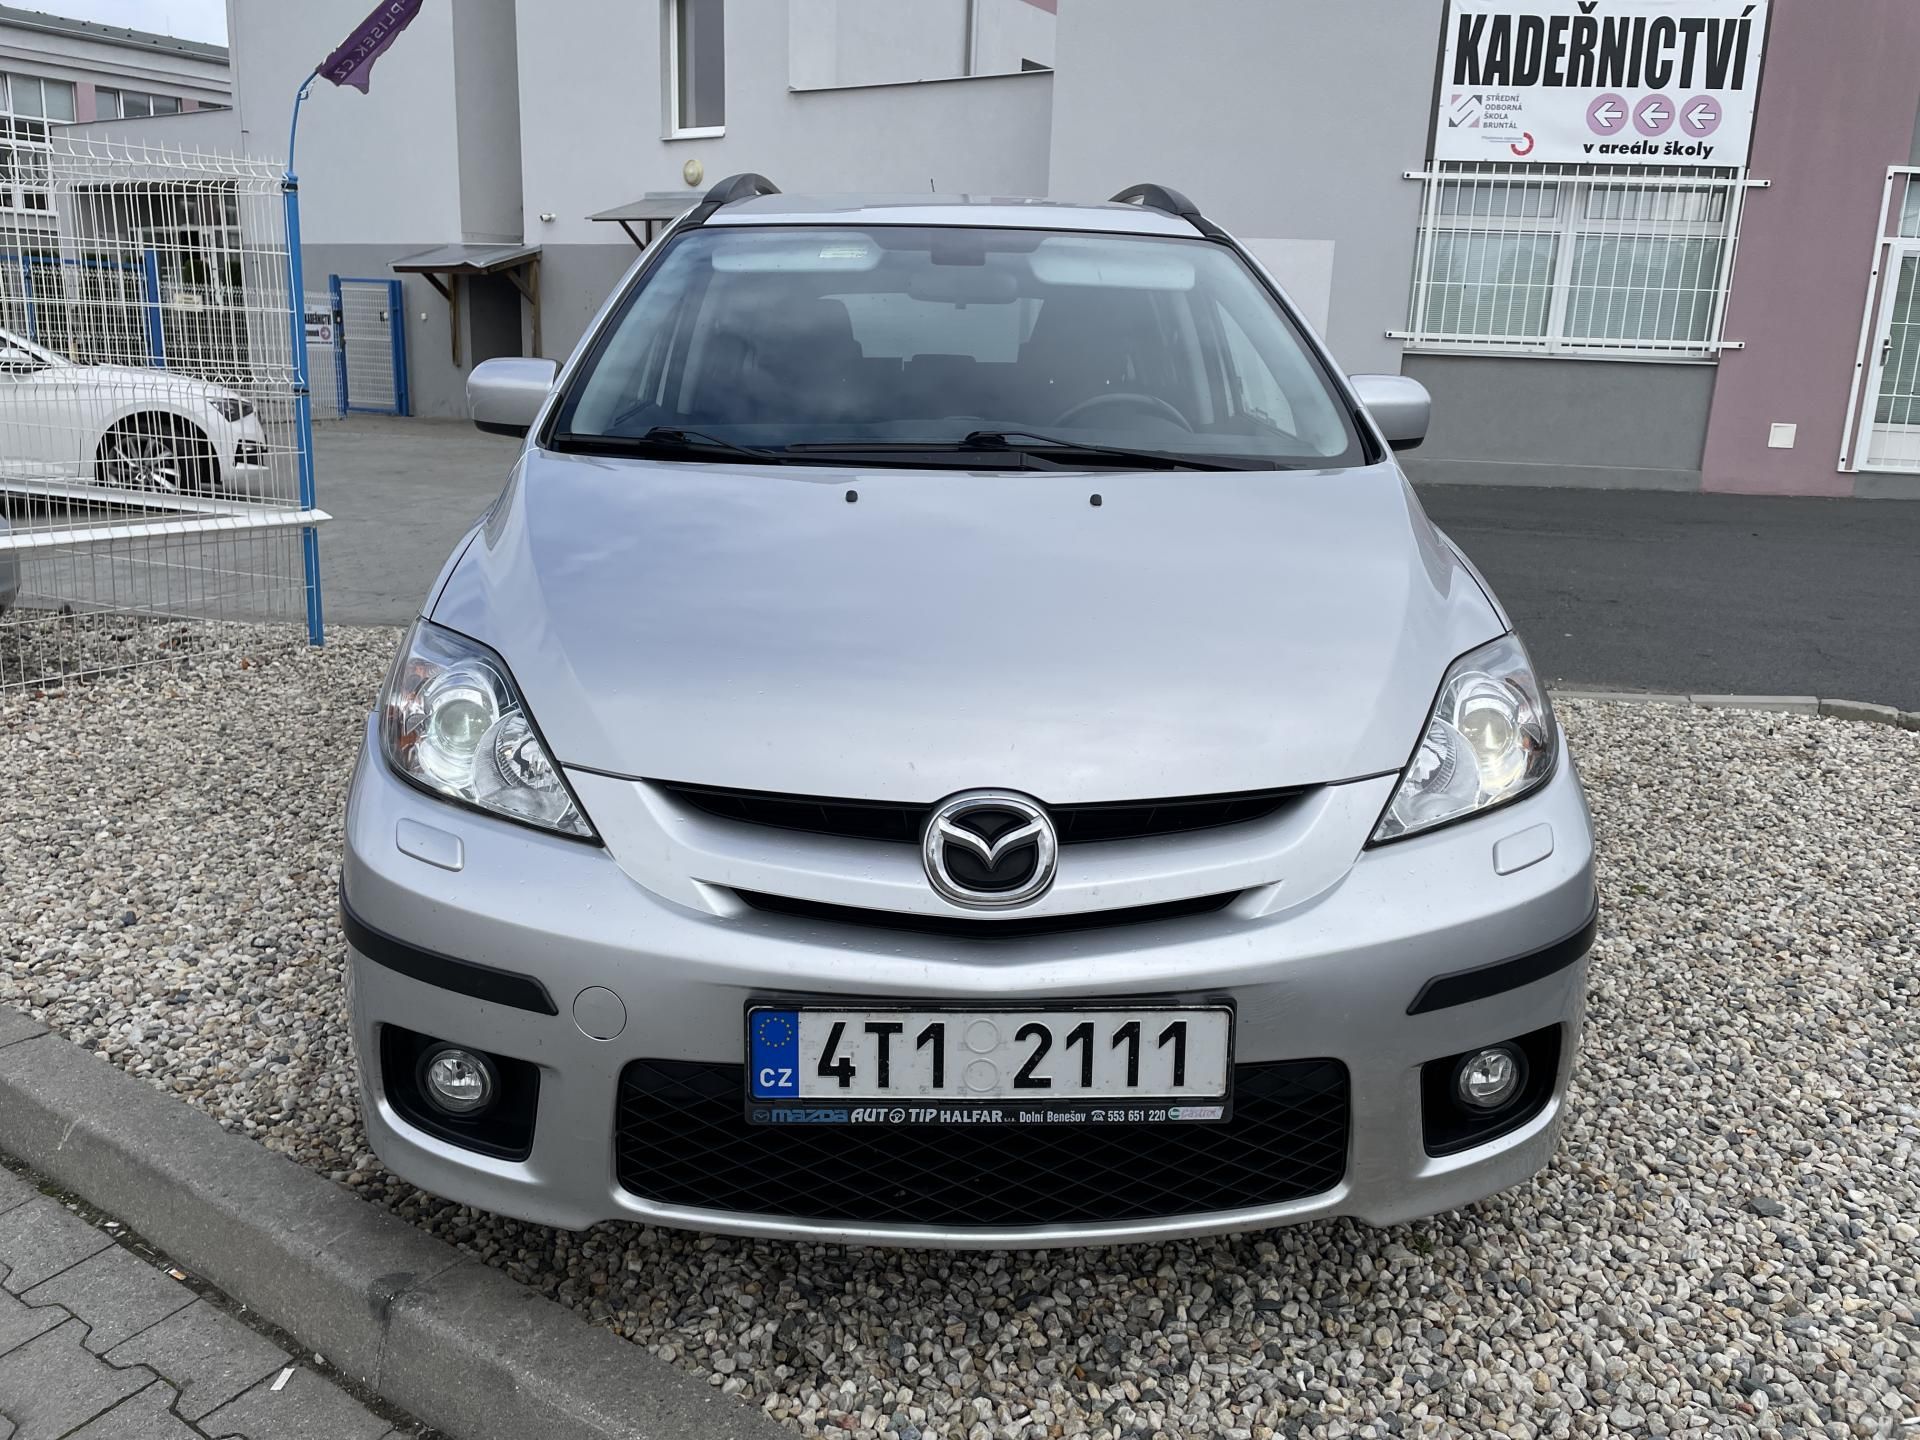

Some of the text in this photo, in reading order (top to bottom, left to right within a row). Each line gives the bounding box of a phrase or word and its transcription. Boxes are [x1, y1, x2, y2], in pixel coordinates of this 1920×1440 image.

[1453, 1, 1757, 90] KADEŘNICTVÍ
[1486, 93, 1519, 102] STŘEDNÍ
[1485, 103, 1522, 111] ODBORNÁ
[1484, 111, 1508, 119] ŠKOLA
[1483, 120, 1517, 129] BRUNTÁL
[1583, 140, 1714, 160] v areálu školy
[817, 1020, 1188, 1089] 4T1 2111
[759, 1068, 793, 1088] CZ
[909, 1109, 937, 1122] TIP
[940, 1110, 1002, 1123] HALFAR
[1019, 1111, 1044, 1123] Dolní
[1047, 1110, 1086, 1123] Benešov
[1107, 1110, 1125, 1121] 553
[1128, 1110, 1145, 1121] 651
[1148, 1110, 1166, 1121] 220
